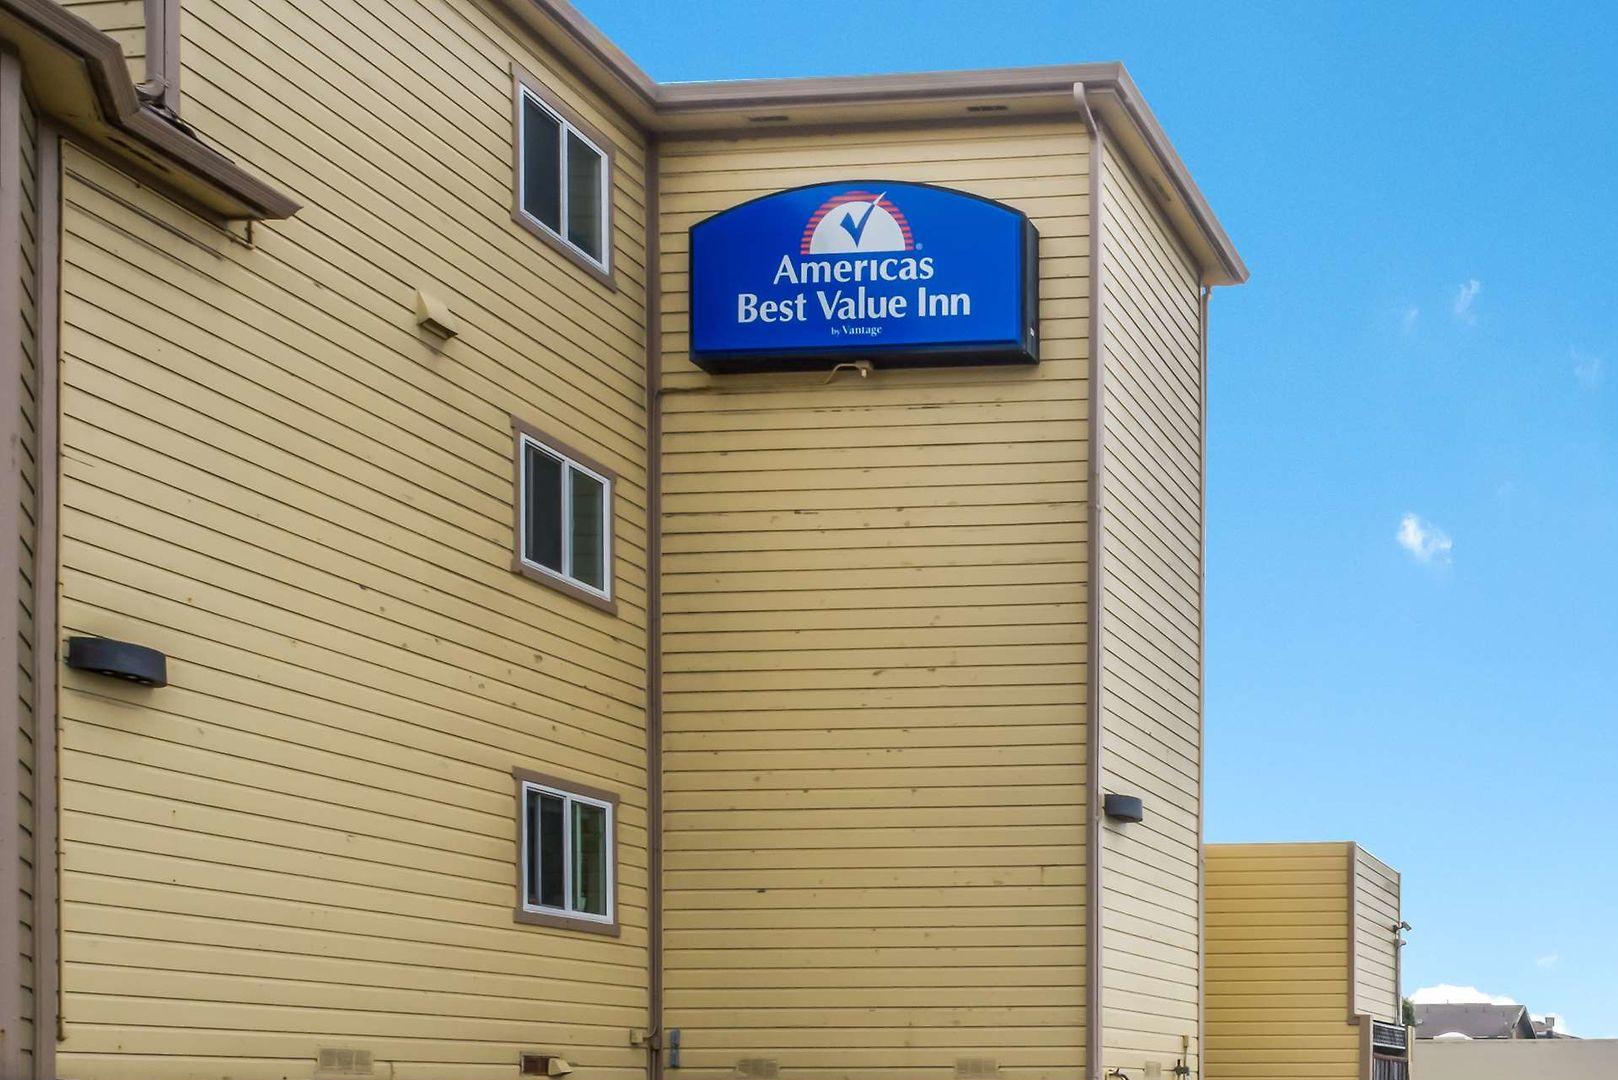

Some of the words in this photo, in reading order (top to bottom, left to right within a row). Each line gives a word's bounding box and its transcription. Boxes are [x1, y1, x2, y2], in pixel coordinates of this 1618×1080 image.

[773, 254, 933, 285] Americas
[738, 293, 806, 323] Best
[817, 286, 907, 320] Value
[918, 286, 971, 316] Inn
[831, 326, 840, 337] by
[842, 324, 882, 336] Vantage
